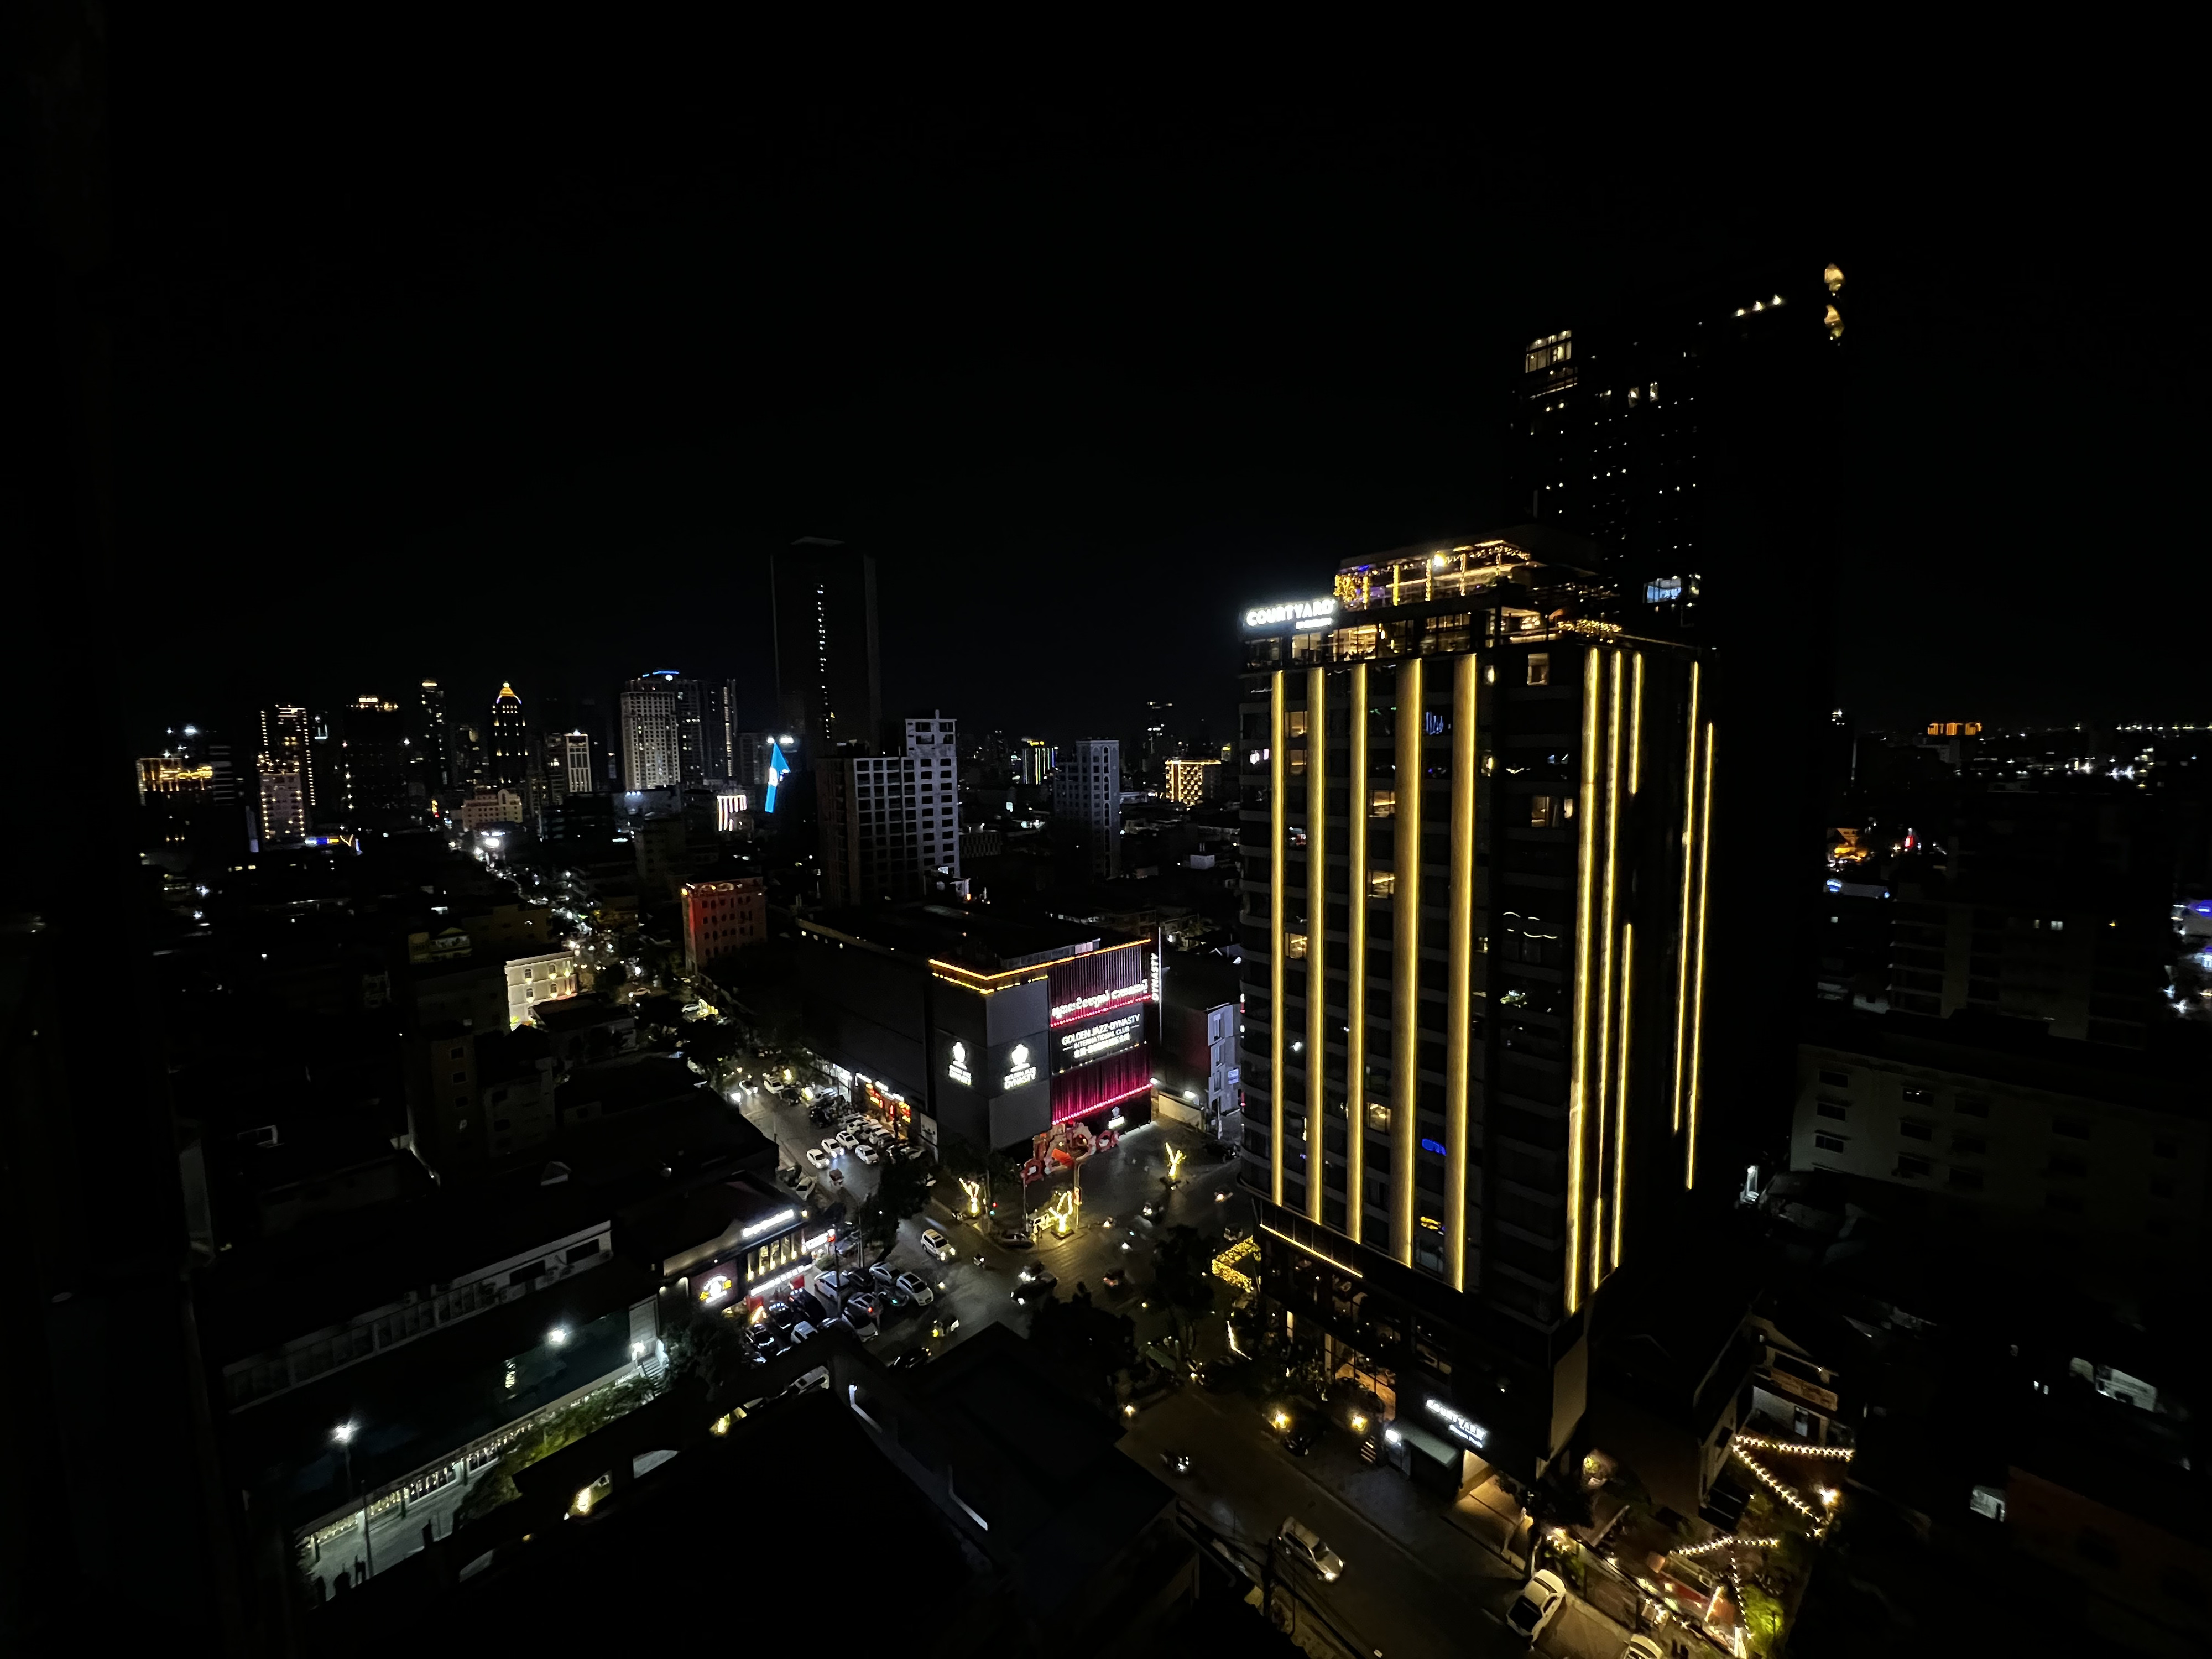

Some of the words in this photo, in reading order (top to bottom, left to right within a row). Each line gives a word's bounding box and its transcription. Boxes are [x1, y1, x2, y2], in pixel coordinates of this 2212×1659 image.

[1246, 599, 1335, 626] COURTYARD
[1061, 1029, 1091, 1046] GOLDEN
[1073, 1031, 1115, 1048] INTERNATIONAL
[1116, 1026, 1130, 1035] CLUB
